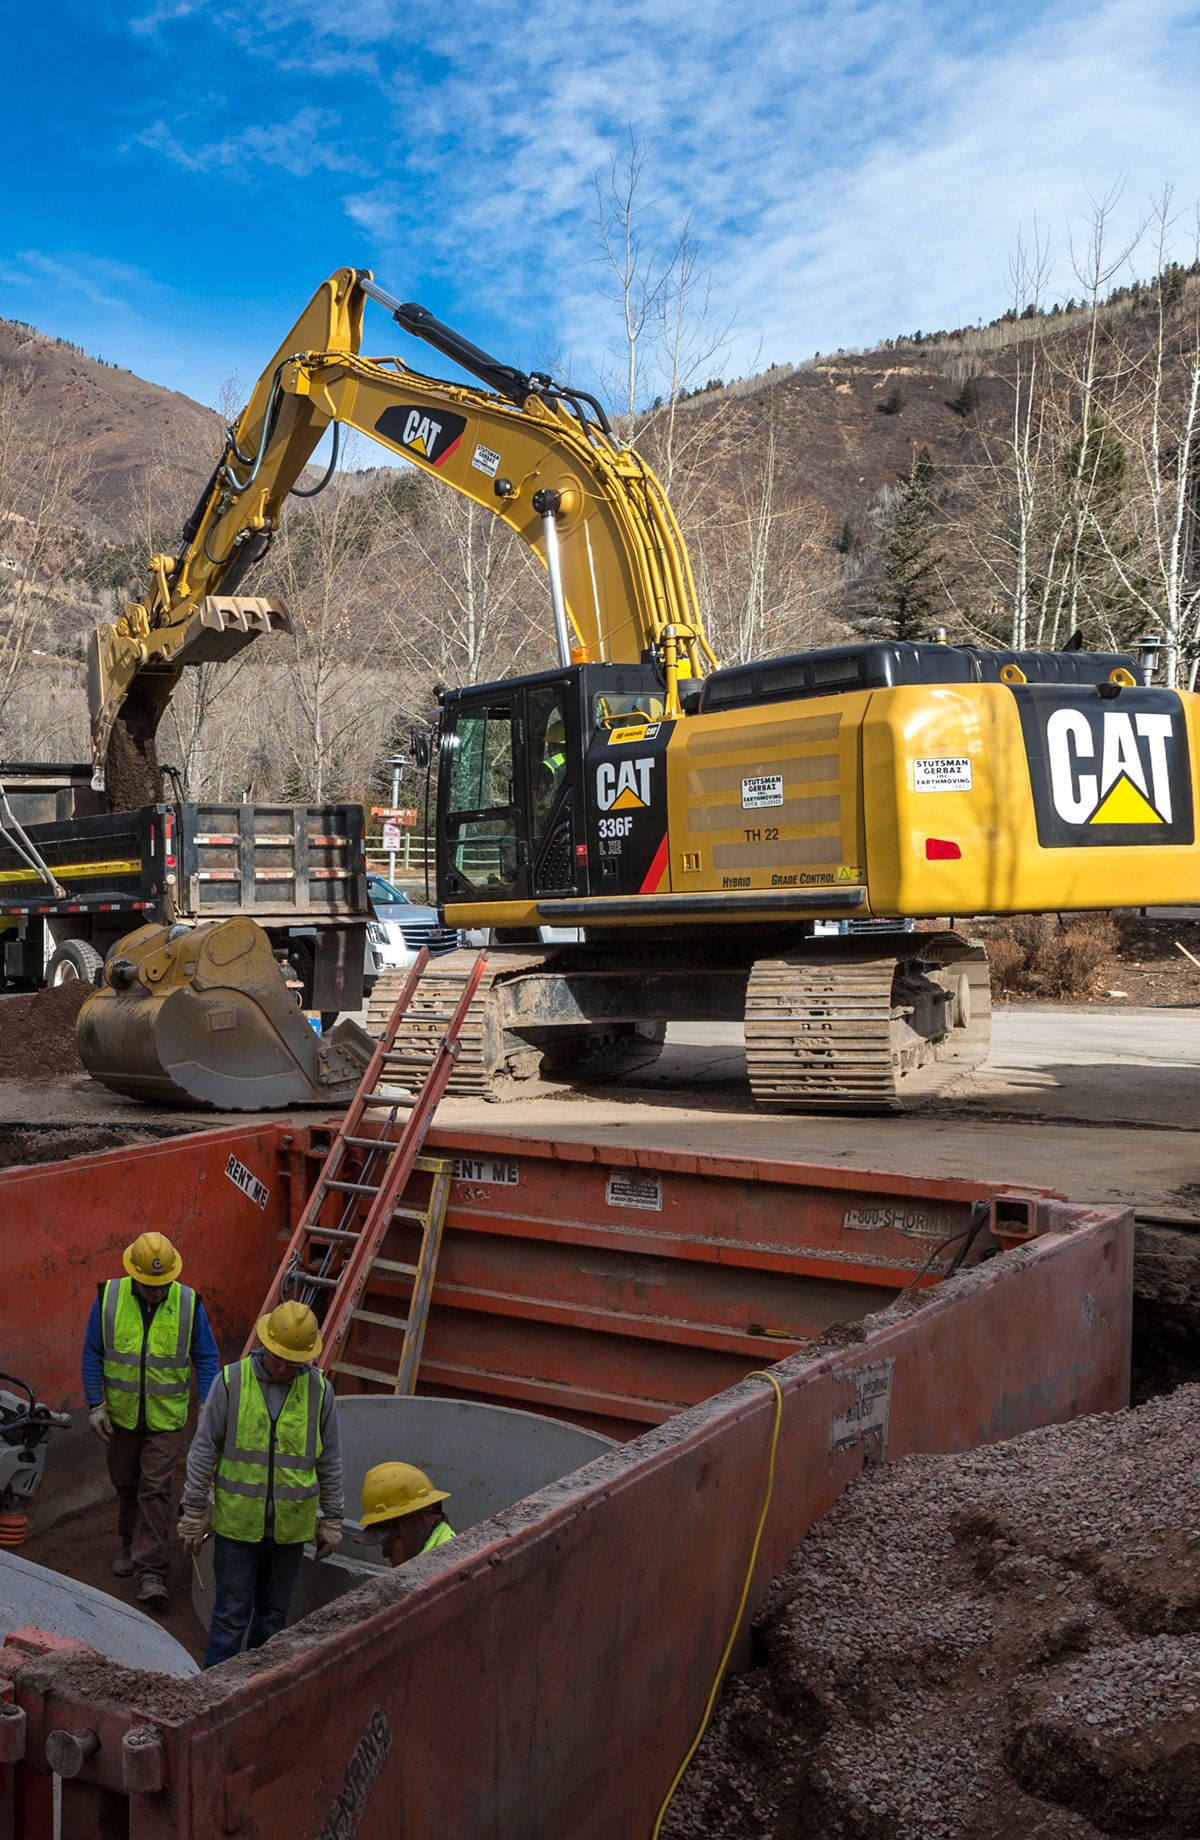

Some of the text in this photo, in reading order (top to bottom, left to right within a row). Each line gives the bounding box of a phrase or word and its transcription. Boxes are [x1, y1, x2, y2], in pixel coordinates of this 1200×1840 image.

[403, 410, 442, 457] CAT
[1047, 709, 1173, 824] CAT
[596, 757, 655, 811] CAT
[744, 777, 781, 786] STUTSMAN
[748, 784, 776, 792] GERBAZ
[744, 794, 782, 802] EARTHMOVING
[599, 816, 632, 838] 336F
[744, 828, 779, 842] TH 22
[227, 1156, 268, 1207] RENT ME
[452, 1160, 518, 1183] ENT ME
[847, 1209, 950, 1231] 1-800-SHORING
